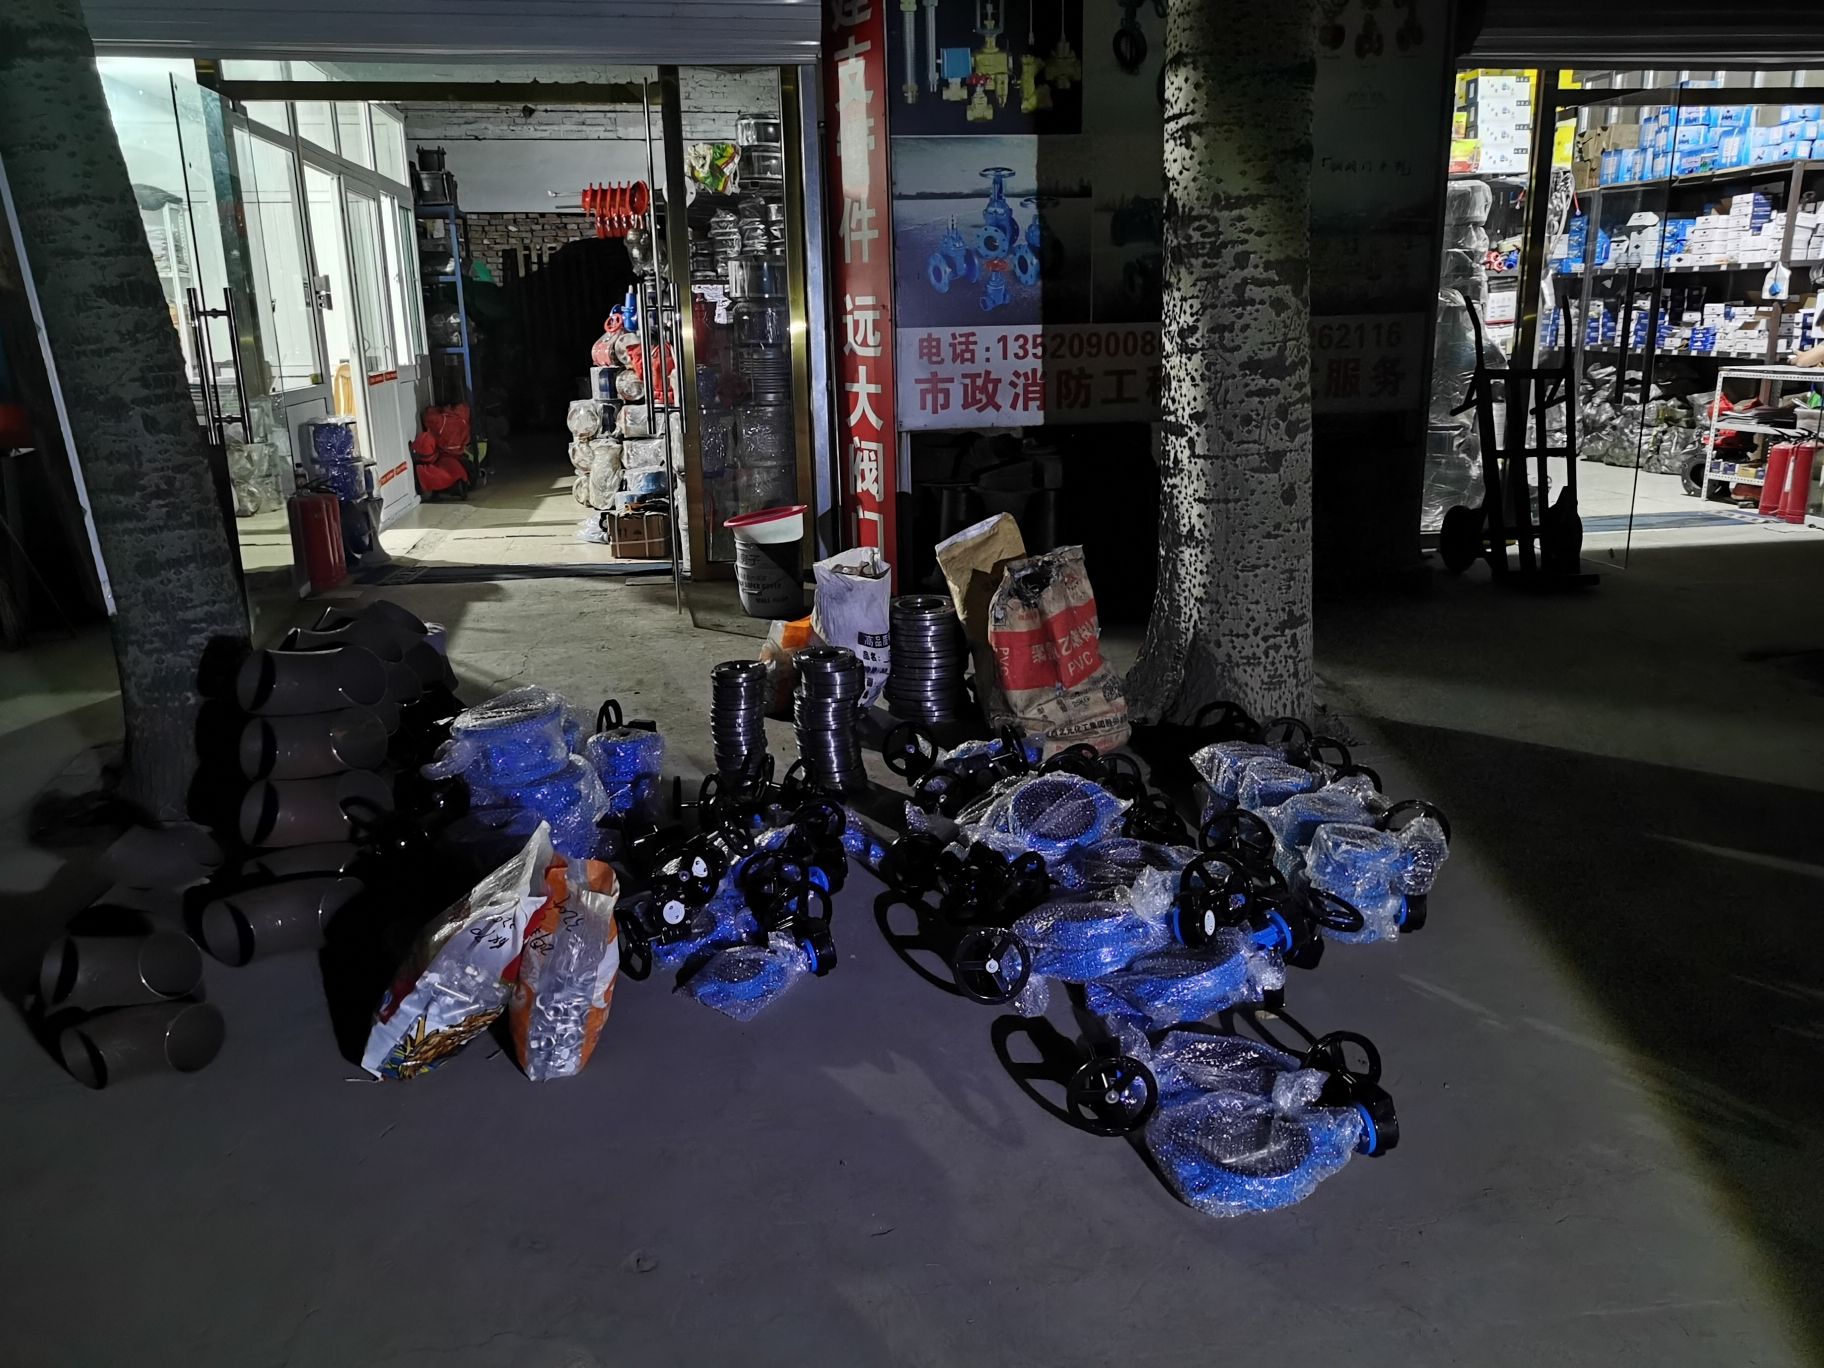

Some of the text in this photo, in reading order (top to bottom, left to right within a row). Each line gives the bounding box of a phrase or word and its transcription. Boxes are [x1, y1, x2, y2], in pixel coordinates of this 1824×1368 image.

[1311, 354, 1405, 402] 服务
[999, 646, 1010, 677] PVC
[1067, 651, 1094, 677] PVC
